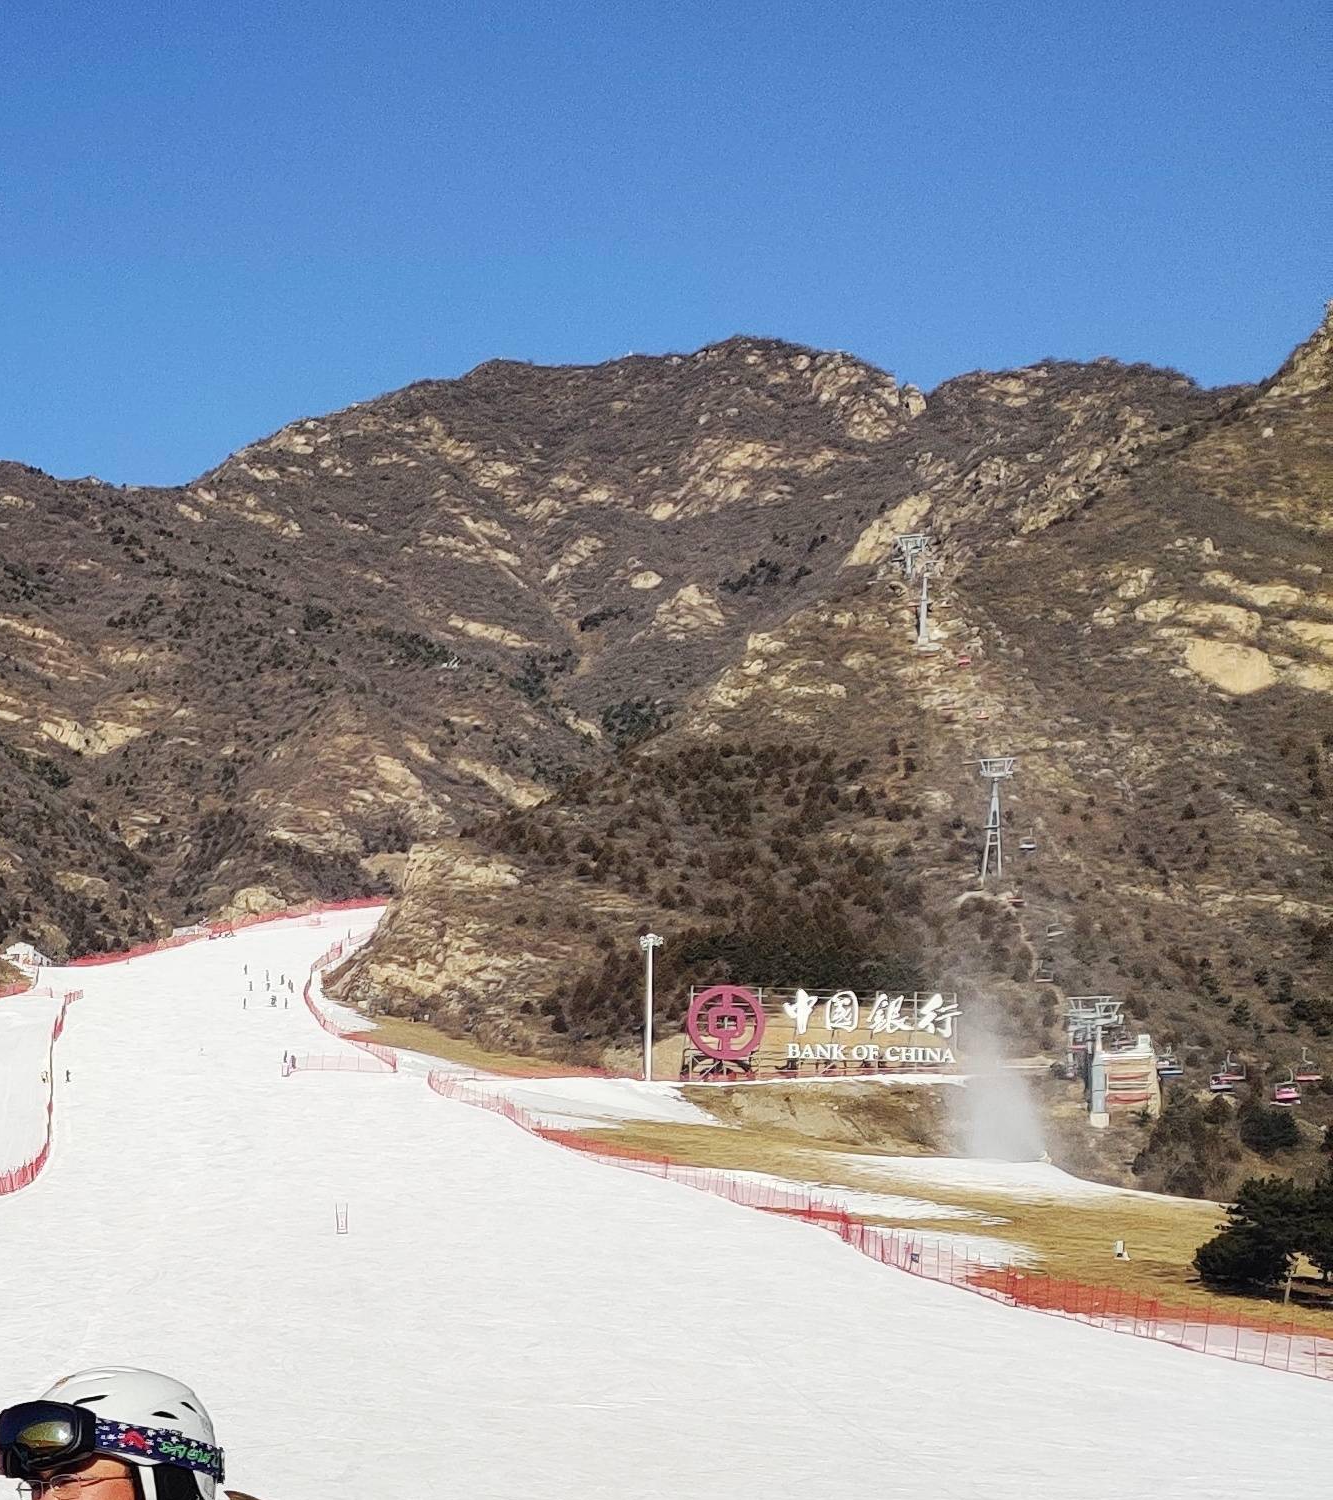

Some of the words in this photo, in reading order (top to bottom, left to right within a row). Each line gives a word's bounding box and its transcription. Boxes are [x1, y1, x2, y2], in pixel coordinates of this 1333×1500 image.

[786, 1043, 848, 1060] BANK
[852, 1044, 879, 1060] OF
[884, 1045, 956, 1063] CHINA
